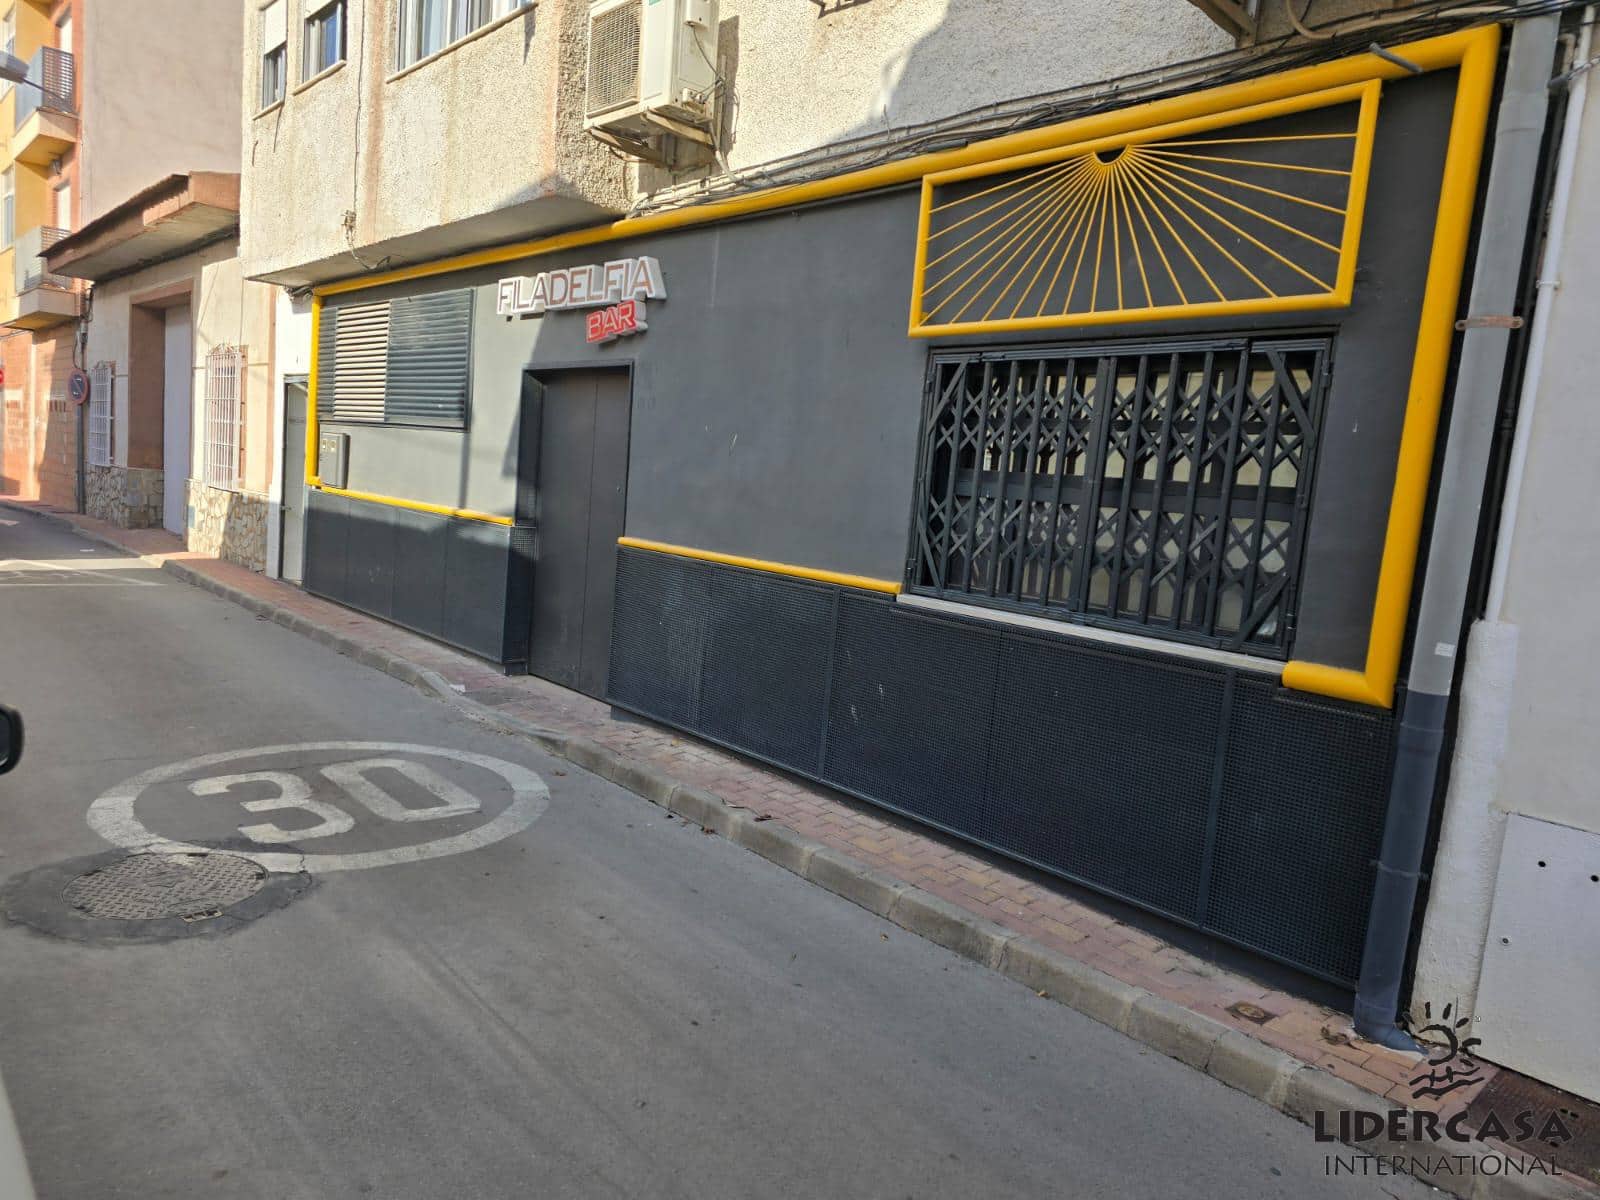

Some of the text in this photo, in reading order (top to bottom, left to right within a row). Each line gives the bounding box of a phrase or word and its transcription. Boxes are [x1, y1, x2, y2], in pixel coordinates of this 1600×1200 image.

[497, 256, 658, 315] FILADELFIA
[586, 300, 637, 343] BAR
[187, 758, 481, 844] 30
